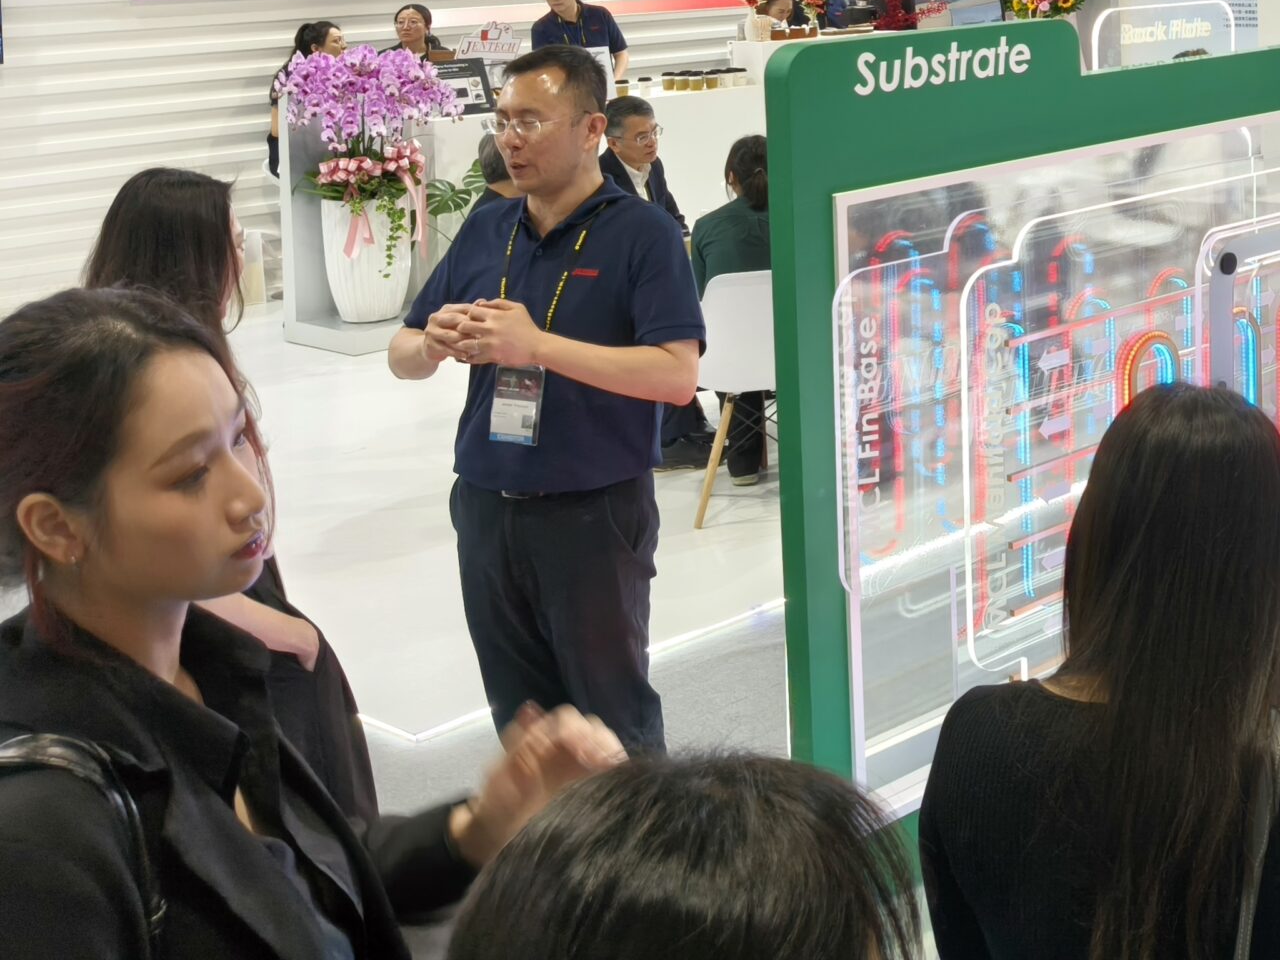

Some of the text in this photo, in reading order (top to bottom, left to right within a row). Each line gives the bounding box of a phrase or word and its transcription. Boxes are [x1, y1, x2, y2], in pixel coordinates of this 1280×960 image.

[461, 38, 518, 56] JENTECH
[854, 35, 1032, 97] Substrate
[857, 316, 880, 401] Base
[858, 411, 880, 460] Fin
